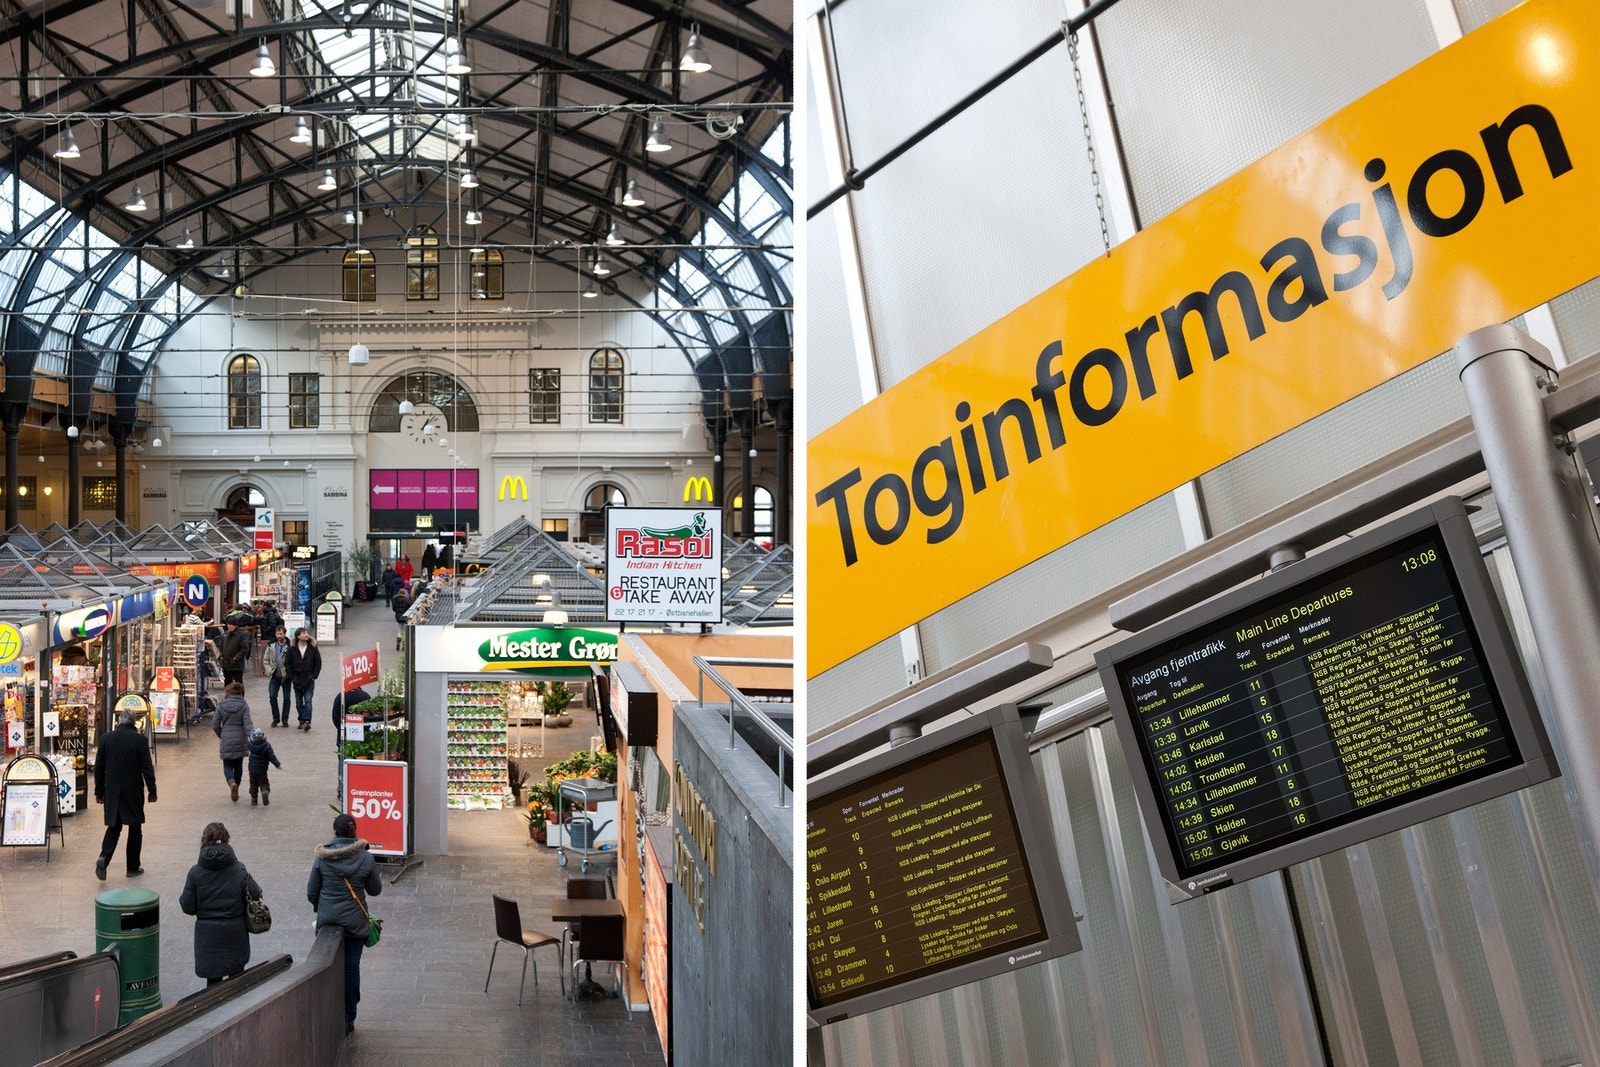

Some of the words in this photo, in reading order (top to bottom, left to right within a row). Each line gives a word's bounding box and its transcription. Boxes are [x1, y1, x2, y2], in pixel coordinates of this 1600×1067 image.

[815, 104, 1573, 566] Toginformasjon
[616, 528, 713, 559] Rasoi
[626, 560, 659, 569] Indian
[662, 560, 702, 570] Kitchen
[1401, 549, 1437, 572] 13:08
[189, 584, 204, 600] N
[620, 576, 717, 590] RESTAURANT
[624, 590, 661, 604] TAKE
[669, 590, 715, 604] AWAY
[614, 608, 625, 616] 22
[627, 608, 636, 616] 17
[637, 608, 646, 616] 21
[648, 608, 656, 616] 17
[665, 608, 714, 617] Østbanehallen
[1235, 624, 1263, 643] Main
[1264, 614, 1289, 631] Line
[1290, 586, 1354, 620] Departures
[1298, 616, 1331, 634] Merknader
[488, 635, 562, 659] Mester
[1261, 632, 1291, 650] Forventet
[1302, 630, 1331, 645] Remarks
[1310, 653, 1342, 670] Lillestrøm
[1342, 649, 1352, 658] og
[1351, 643, 1368, 654] Oslo
[1367, 631, 1397, 647] Lufthavn
[1396, 627, 1407, 636] før
[1407, 614, 1435, 631] Eidsvoll
[1131, 664, 1170, 688] Avgang
[1169, 639, 1227, 672] fjerntrafikk
[1236, 649, 1251, 660] Spor
[1265, 643, 1295, 661] Expected
[0, 663, 18, 674] tek
[352, 656, 374, 674] 120,-
[1239, 659, 1258, 671] Track
[1318, 667, 1380, 696] NSB/Tågkompaniet
[1384, 652, 1420, 670] Påstigning
[1419, 647, 1429, 656] 15
[1429, 643, 1443, 653] min
[1443, 638, 1454, 647] før
[1168, 680, 1182, 688] Tog
[1172, 682, 1205, 700] Destination
[1322, 695, 1335, 704] avg
[1338, 682, 1368, 698] Boarding
[1368, 676, 1378, 686] 15
[1377, 673, 1391, 682] min
[1390, 664, 1414, 677] before
[1414, 658, 1428, 668] dep
[1136, 689, 1158, 702] Avgang
[1139, 698, 1167, 713] Departure
[1149, 716, 1172, 732] 13:34
[1178, 693, 1230, 720] Lillehammer
[1249, 679, 1261, 691] 11
[1327, 710, 1348, 721] Råde,
[1347, 693, 1384, 713] Fredrikstad
[1384, 691, 1395, 700] og
[1394, 678, 1430, 695] Sarpsborg
[1154, 732, 1177, 748] 13:39
[1183, 719, 1210, 737] Larvik
[1259, 695, 1267, 706] 5
[1333, 719, 1374, 738] Lillehammer.
[1374, 703, 1414, 722] Forbindelse
[1413, 699, 1422, 708] til
[1421, 687, 1457, 705] Åndalsnes
[348, 727, 362, 735] 120,-
[1159, 748, 1183, 764] 13:46
[1188, 731, 1225, 753] Karlstad
[1260, 712, 1273, 724] 15
[58, 738, 84, 750] VINN
[1164, 764, 1188, 780] 14:02
[1194, 751, 1225, 769] Halden
[1266, 729, 1278, 741] 18
[1169, 780, 1193, 796] 14:02
[1199, 762, 1246, 785] Trondheim
[1271, 745, 1282, 758] 17
[1356, 793, 1385, 807] Nydalen,
[1385, 783, 1411, 797] Kjelsås
[1411, 780, 1421, 788] og
[1420, 769, 1448, 784] Nittedal
[1447, 766, 1458, 775] før
[1459, 757, 1486, 771] Furumo
[350, 788, 394, 798] Grønnplanter
[1174, 796, 1198, 812] 14:34
[1204, 776, 1257, 802] Lillehammer
[1277, 763, 1289, 774] 11
[351, 797, 402, 820] 50%
[1179, 813, 1203, 829] 14:39
[1210, 803, 1235, 818] Skien
[1287, 779, 1295, 790] 5
[1184, 829, 1208, 845] 15:02
[1215, 817, 1247, 835] Halden
[1288, 796, 1301, 808] 18
[807, 846, 828, 859] Mysen
[851, 831, 860, 842] 10
[1189, 846, 1214, 861] 15:02
[1220, 833, 1250, 851] Gjøvik
[1293, 813, 1306, 825] 16
[811, 862, 822, 873] Ski
[858, 846, 864, 856] 9
[814, 876, 830, 887] Oslo
[830, 867, 852, 882] Airport
[858, 860, 868, 871] 13
[818, 882, 852, 902] Spikkestad
[865, 875, 871, 884] 7
[821, 899, 853, 916] Lillestrøm
[869, 890, 875, 899] 9
[807, 924, 822, 936] 3:42
[826, 918, 844, 930] Jaren
[870, 904, 879, 915] 16
[829, 933, 841, 945] Dal
[873, 919, 883, 929] 10
[833, 946, 856, 959] Skøyen
[880, 934, 887, 944] 8
[836, 958, 867, 974] Drammen
[885, 949, 891, 958] 4
[129, 978, 157, 991] AVFALL
[840, 973, 865, 988] Eidsvoll
[885, 964, 895, 974] 10
